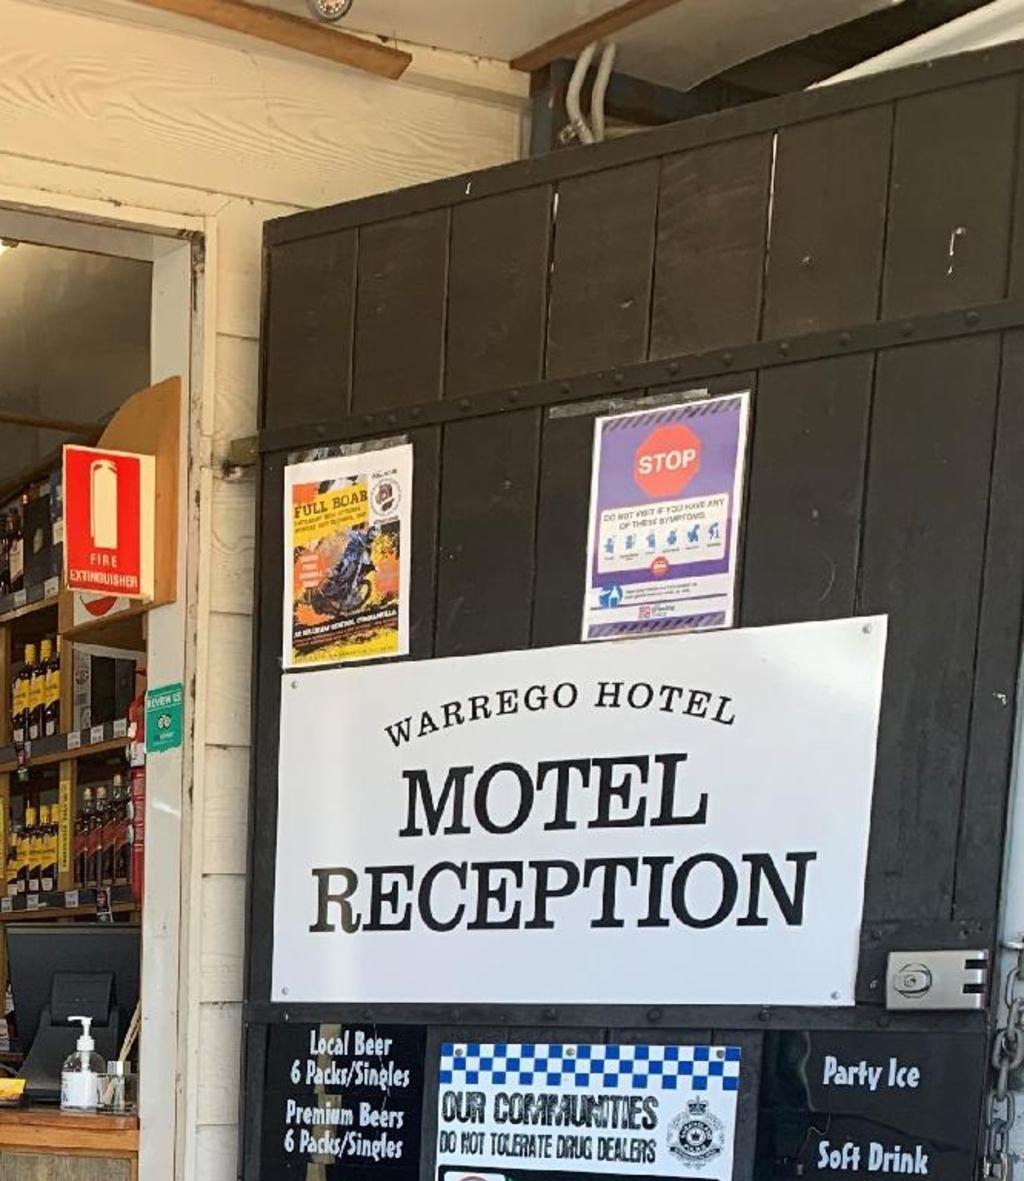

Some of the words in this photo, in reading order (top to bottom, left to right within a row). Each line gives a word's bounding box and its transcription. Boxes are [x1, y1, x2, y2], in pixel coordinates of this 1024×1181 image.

[639, 448, 696, 474] STOP
[294, 500, 328, 519] FULL
[90, 553, 118, 567] FIRE
[70, 570, 138, 588] EXTINGUISHER
[385, 682, 578, 748] WARREGO
[594, 681, 737, 726] HOTEL
[398, 753, 709, 838] MOTEL
[308, 851, 817, 934] RECEPTION
[309, 1029, 349, 1057] Local
[354, 1030, 392, 1056] Beer
[290, 1059, 301, 1085] 6
[305, 1057, 410, 1089] Packs/Singles
[822, 1055, 883, 1092] Party
[888, 1057, 921, 1089] Ice
[286, 1099, 354, 1127] Premium
[359, 1101, 404, 1129] Beers
[442, 1090, 486, 1124] OUR
[493, 1091, 659, 1130] COMMUNITIES
[284, 1128, 295, 1152] 6
[299, 1128, 403, 1162] Packs/Singles
[439, 1130, 457, 1153] DO
[460, 1131, 485, 1155] NOT
[490, 1132, 552, 1159] TOLERATE
[556, 1134, 593, 1160] DRUG
[597, 1136, 657, 1163] DEALERS
[817, 1140, 861, 1171] Soft
[868, 1142, 929, 1175] Drink
